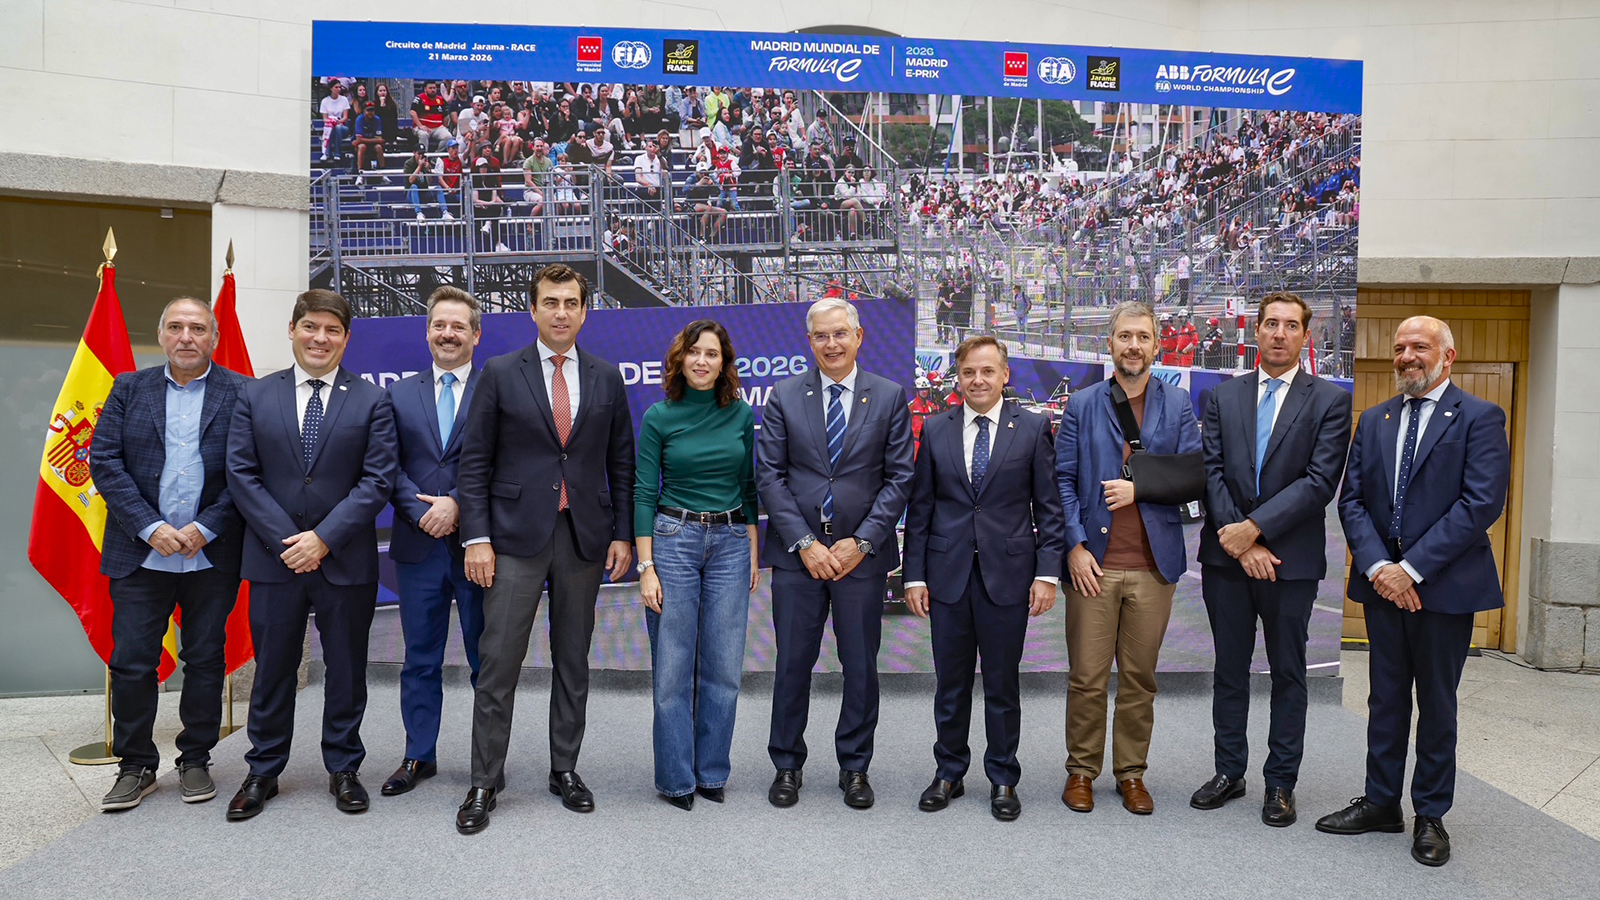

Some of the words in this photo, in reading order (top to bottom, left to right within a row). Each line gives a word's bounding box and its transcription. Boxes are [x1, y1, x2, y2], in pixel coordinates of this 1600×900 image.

[385, 40, 420, 49] Circuito
[421, 41, 433, 49] de
[434, 42, 467, 50] Madrid
[471, 42, 505, 51] Jarama
[510, 43, 536, 52] RACE
[751, 40, 802, 52] MADRID
[803, 43, 861, 54] MUNDIAL
[863, 45, 880, 55] DE
[906, 46, 934, 56] 2026
[428, 53, 440, 61] 21
[441, 53, 468, 61] Marzo
[469, 54, 492, 62] 2026
[905, 57, 948, 68] MADRID
[905, 69, 940, 79] E-PRIX
[1155, 65, 1190, 80] ABB
[1090, 81, 1117, 89] RACE
[1173, 84, 1201, 92] WORLD
[1203, 85, 1265, 94] CHAMPIONSHIP
[734, 355, 809, 378] 2026
